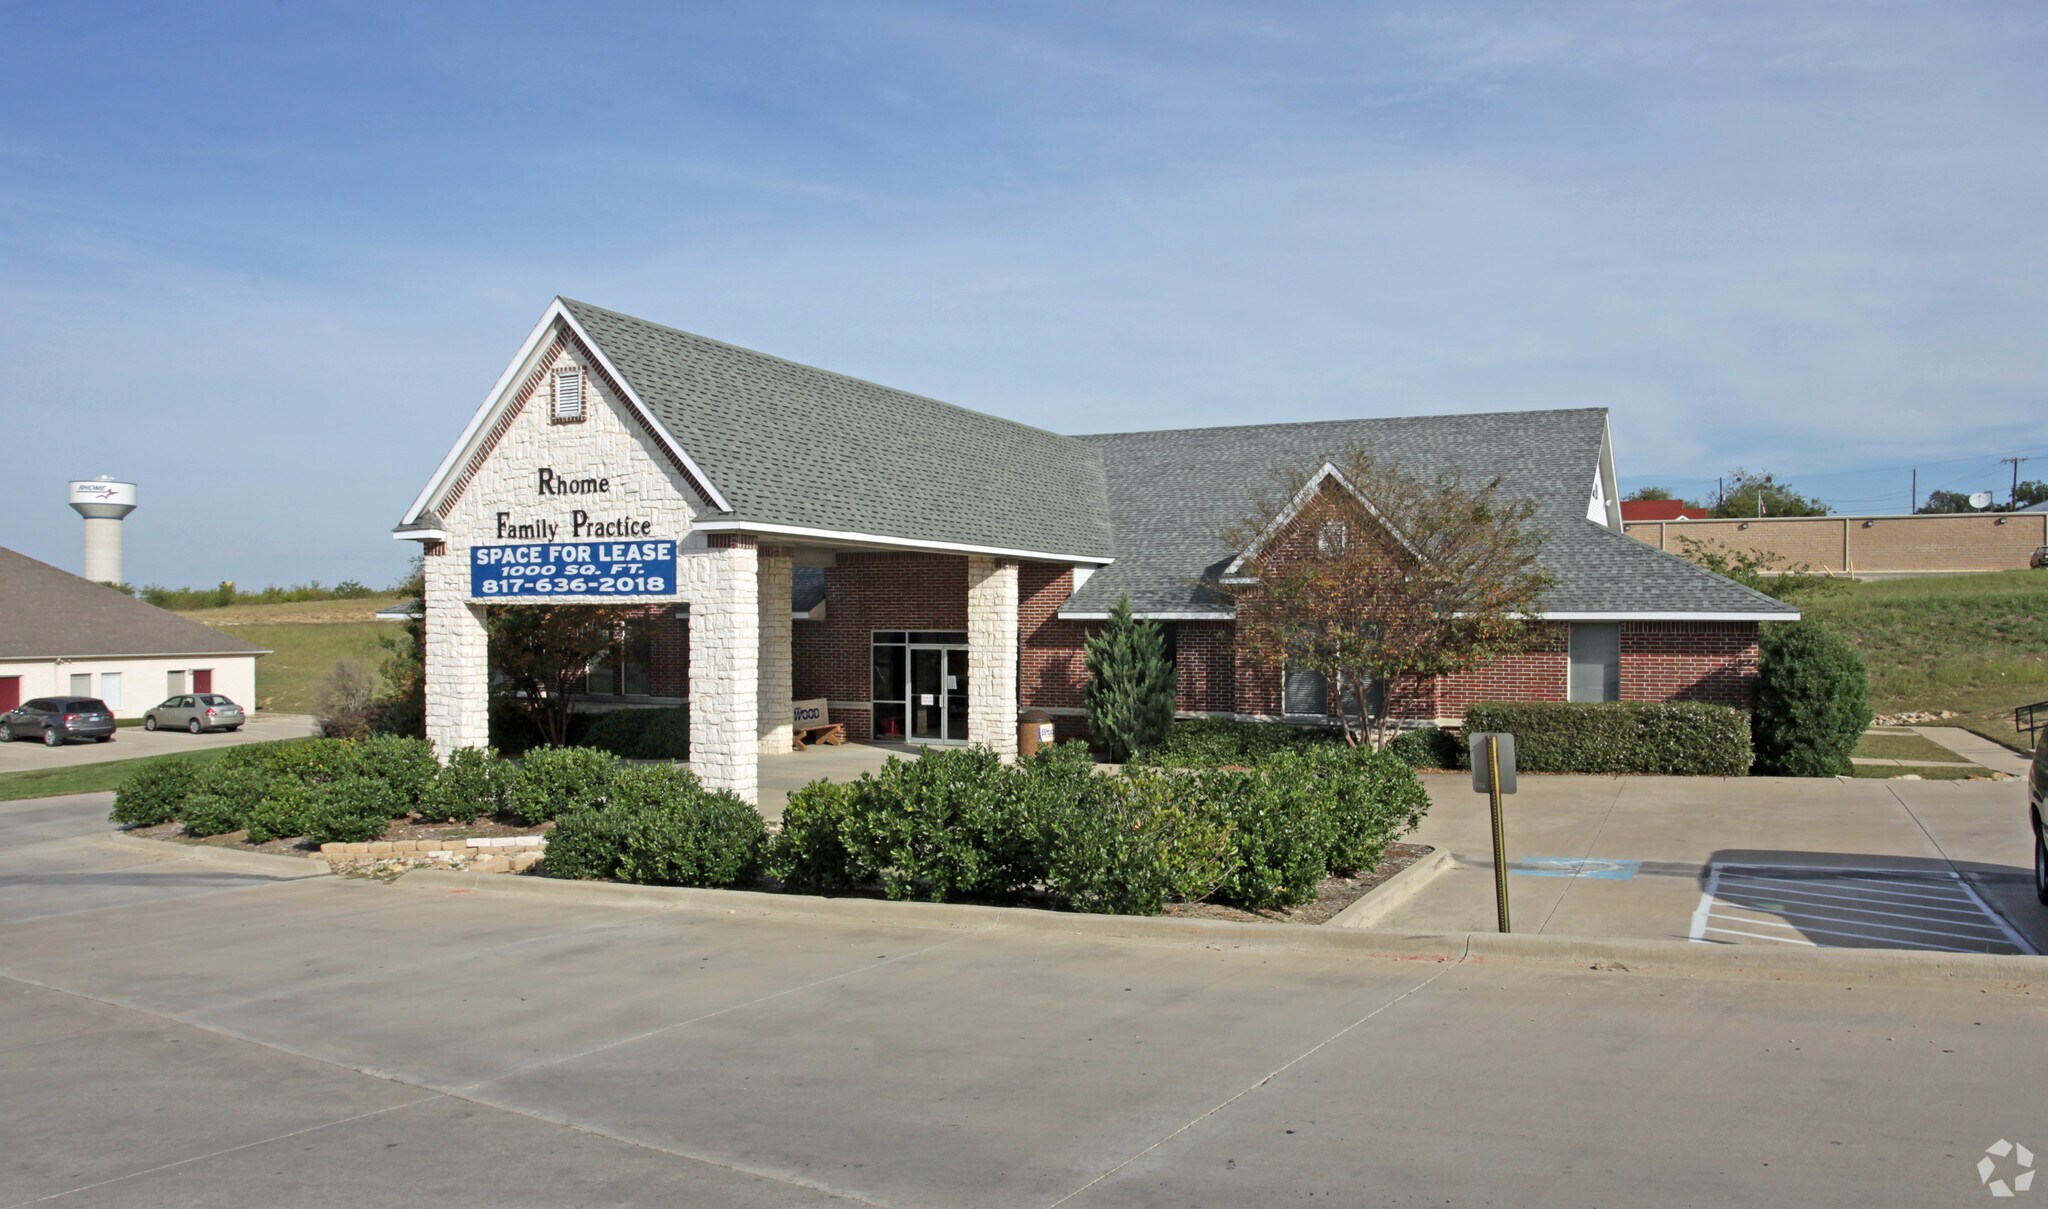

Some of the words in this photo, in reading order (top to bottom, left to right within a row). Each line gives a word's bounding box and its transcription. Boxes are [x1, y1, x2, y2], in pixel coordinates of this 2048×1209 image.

[538, 467, 610, 496] Rhome
[496, 512, 559, 542] Family
[572, 510, 651, 538] Practice
[476, 546, 542, 565] SPACE
[549, 545, 592, 563] FOR
[599, 543, 671, 562] LEASE
[501, 565, 556, 576] 1000
[564, 564, 601, 575] SQ.
[610, 563, 645, 574] FT.
[482, 577, 665, 593] 817-636-2018
[794, 709, 820, 721] WOOD
